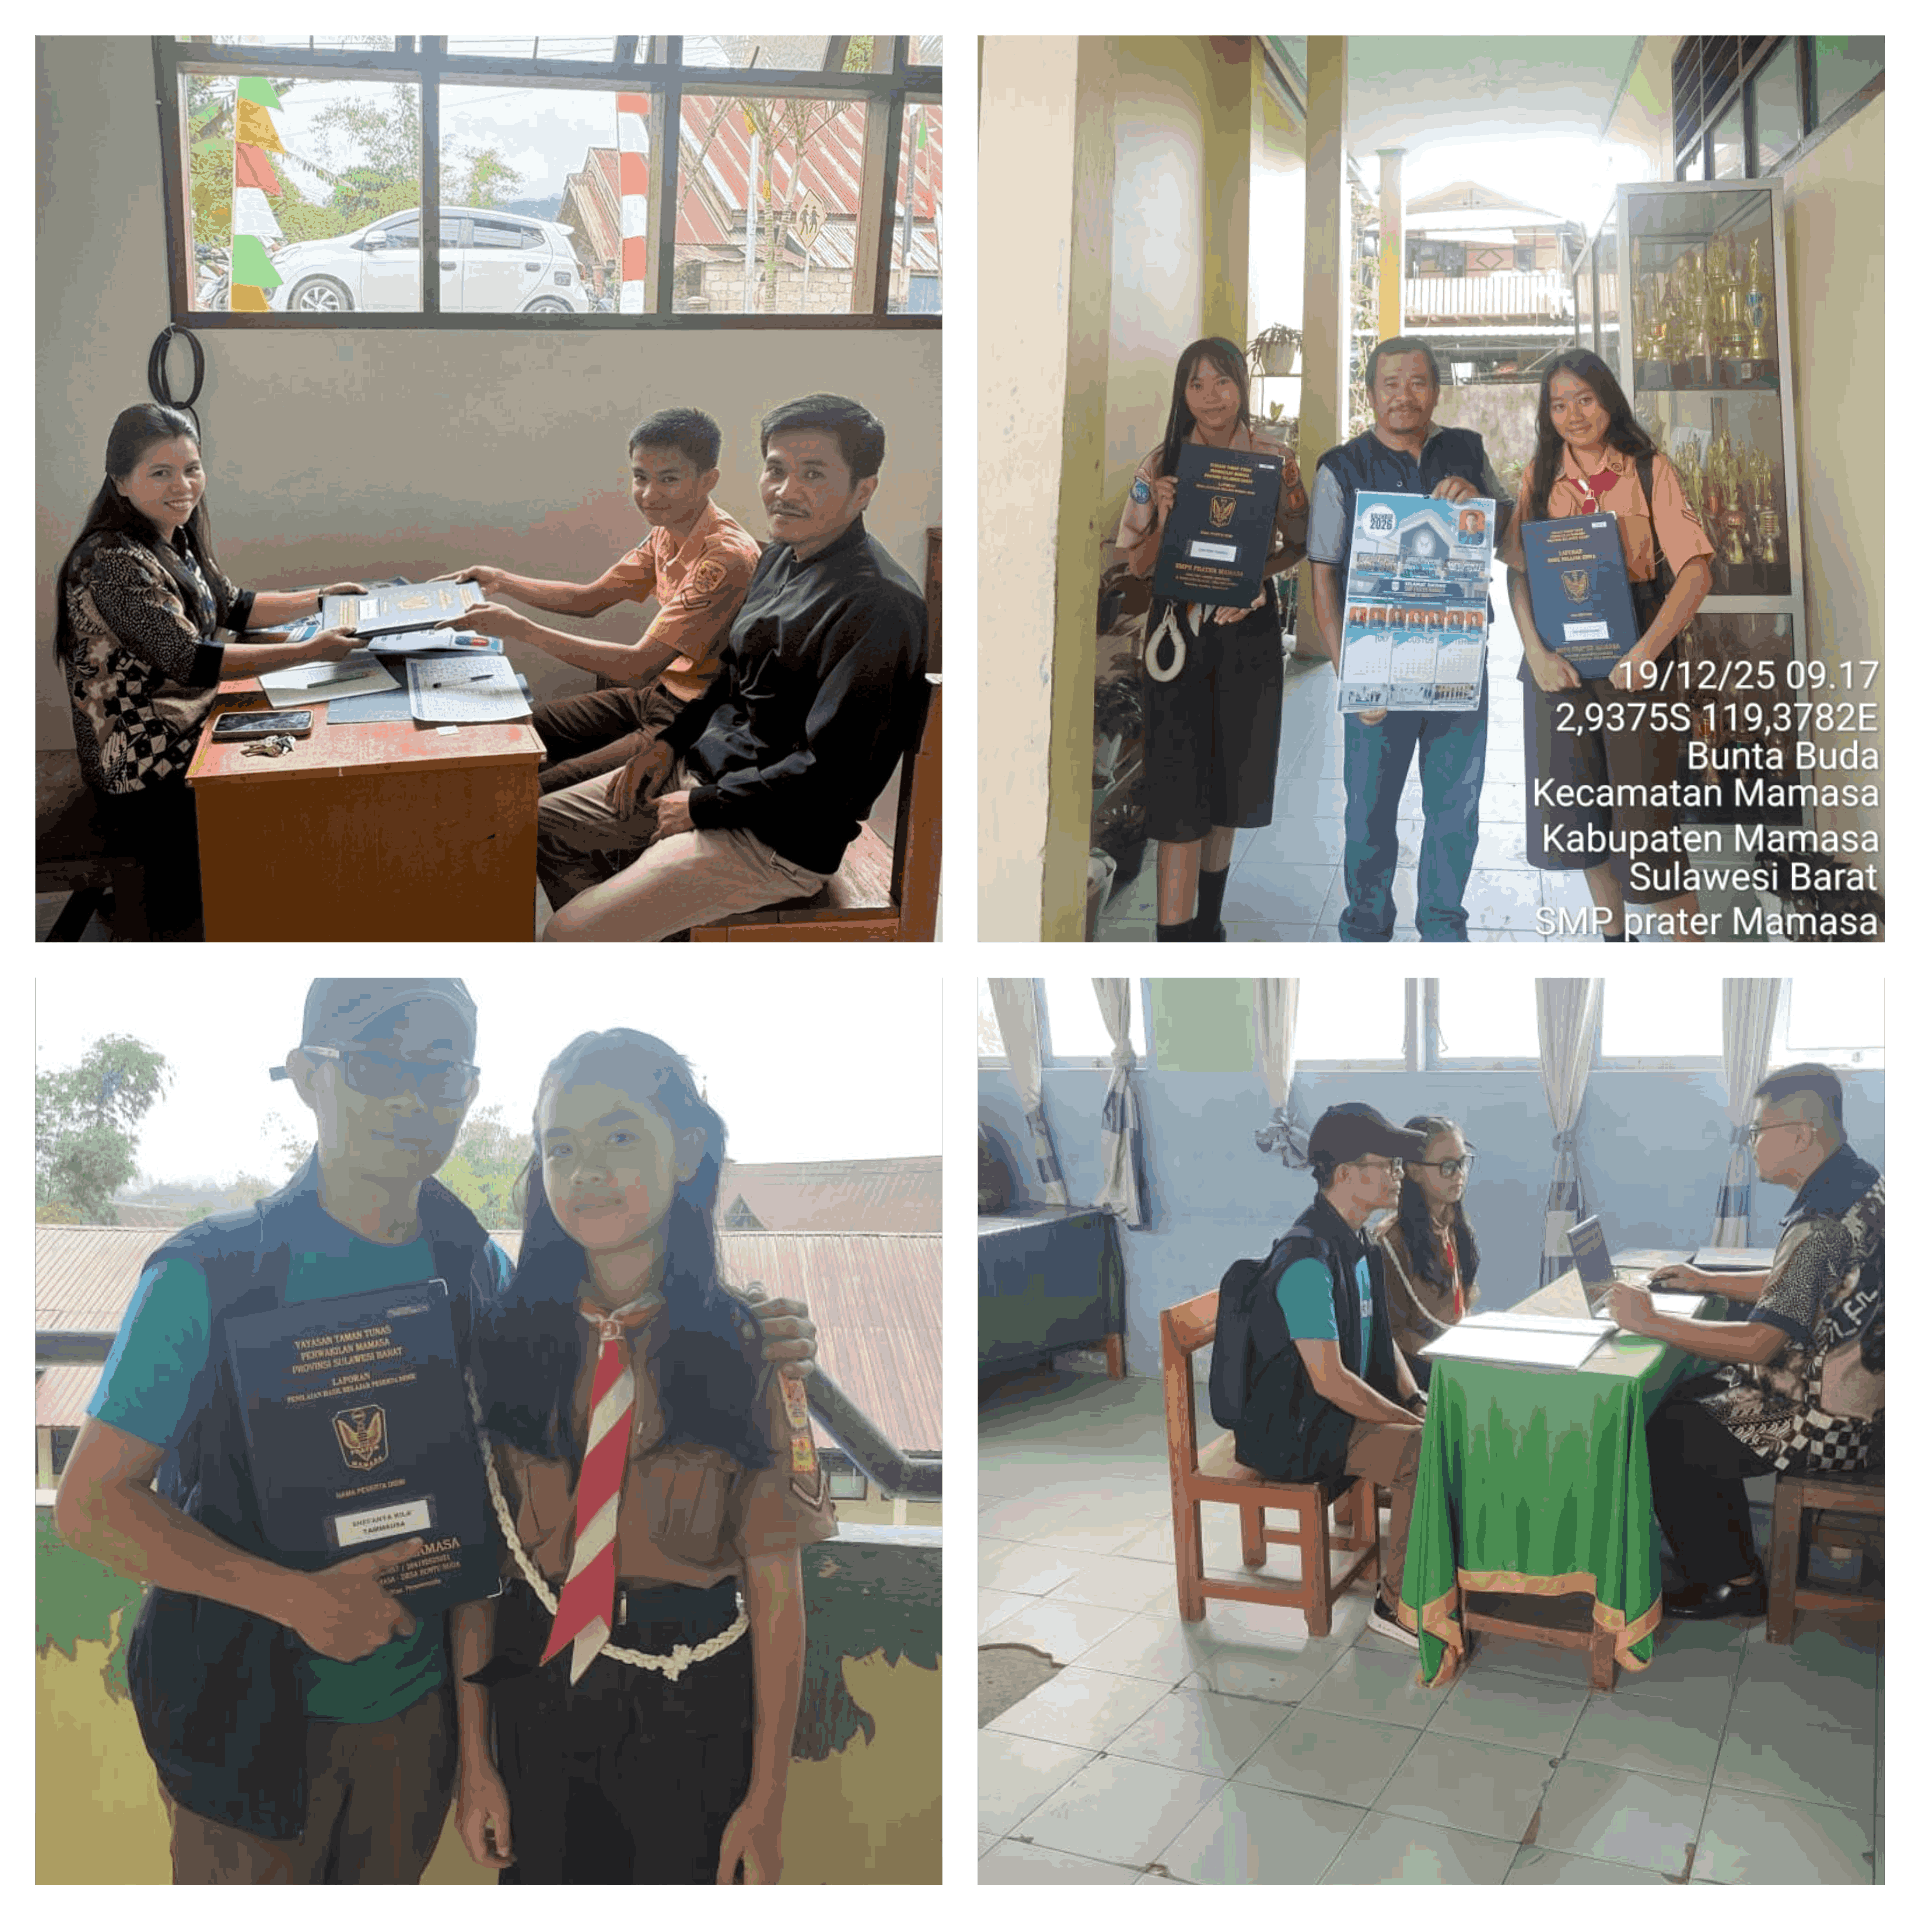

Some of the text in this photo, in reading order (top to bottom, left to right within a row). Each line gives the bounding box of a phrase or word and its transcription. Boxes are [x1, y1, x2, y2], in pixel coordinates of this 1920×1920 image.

[1370, 518, 1393, 530] 2026
[294, 1324, 391, 1350] YAYASAN TAMAN TUNAS
[292, 1346, 402, 1374] PROVINSI SULAWESI BARAT
[301, 1338, 390, 1361] PERWAKILAN MAMASA
[332, 1372, 371, 1386] LAPORAN
[417, 1537, 461, 1557] AMASA
